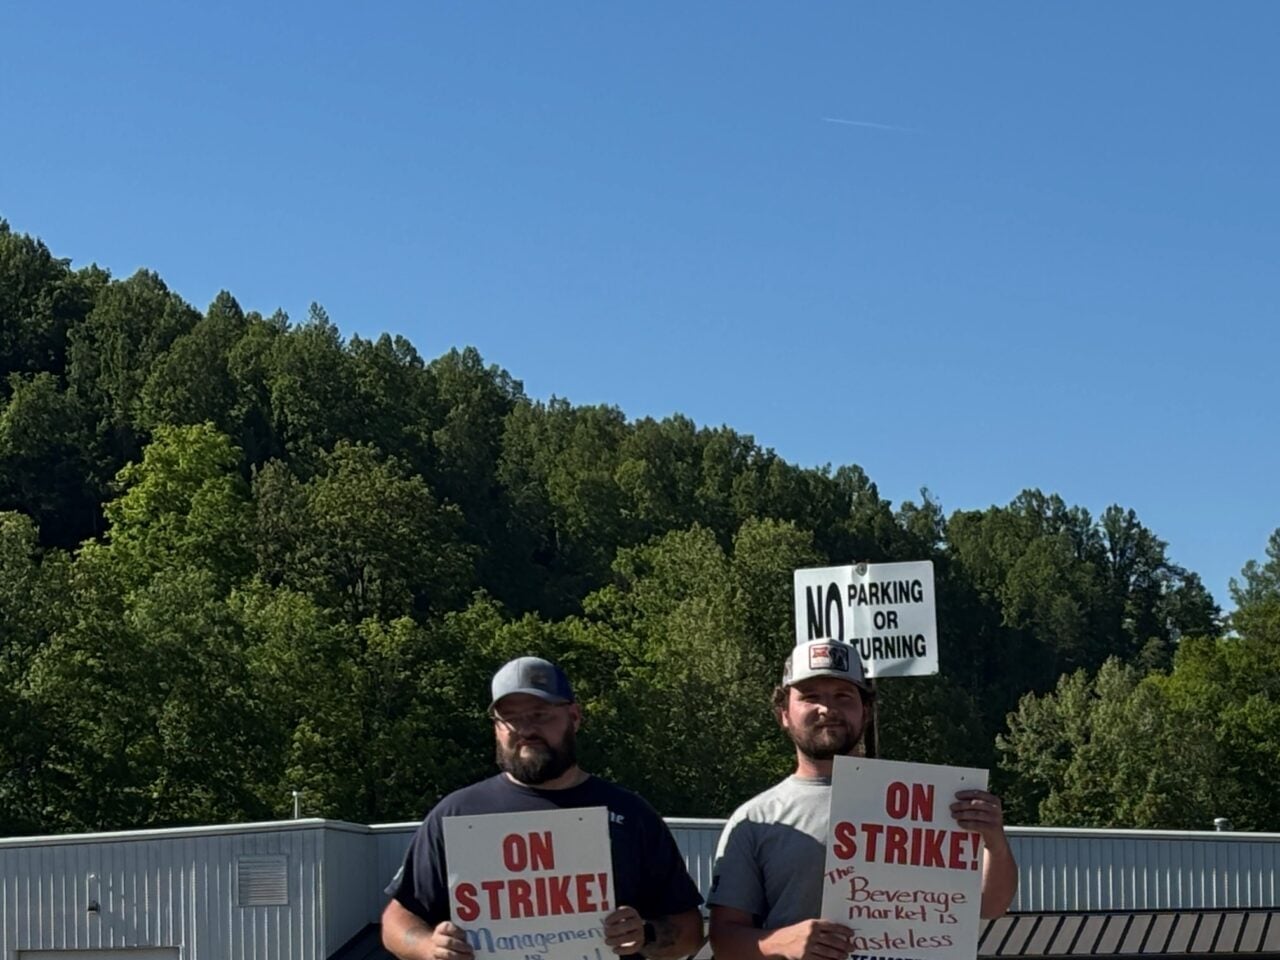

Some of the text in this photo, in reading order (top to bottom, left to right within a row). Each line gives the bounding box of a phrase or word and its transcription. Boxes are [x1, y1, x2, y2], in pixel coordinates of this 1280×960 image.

[806, 582, 844, 641] NO
[848, 579, 923, 607] PARKING
[873, 611, 898, 630] OR
[885, 781, 935, 822] ON
[502, 831, 555, 872] ON
[833, 822, 981, 871] STRIKE!
[824, 865, 855, 885] The
[455, 873, 610, 922] STRIKE!
[846, 876, 966, 913] Beverage
[464, 920, 606, 953] Managemen
[852, 928, 953, 951] asteless
